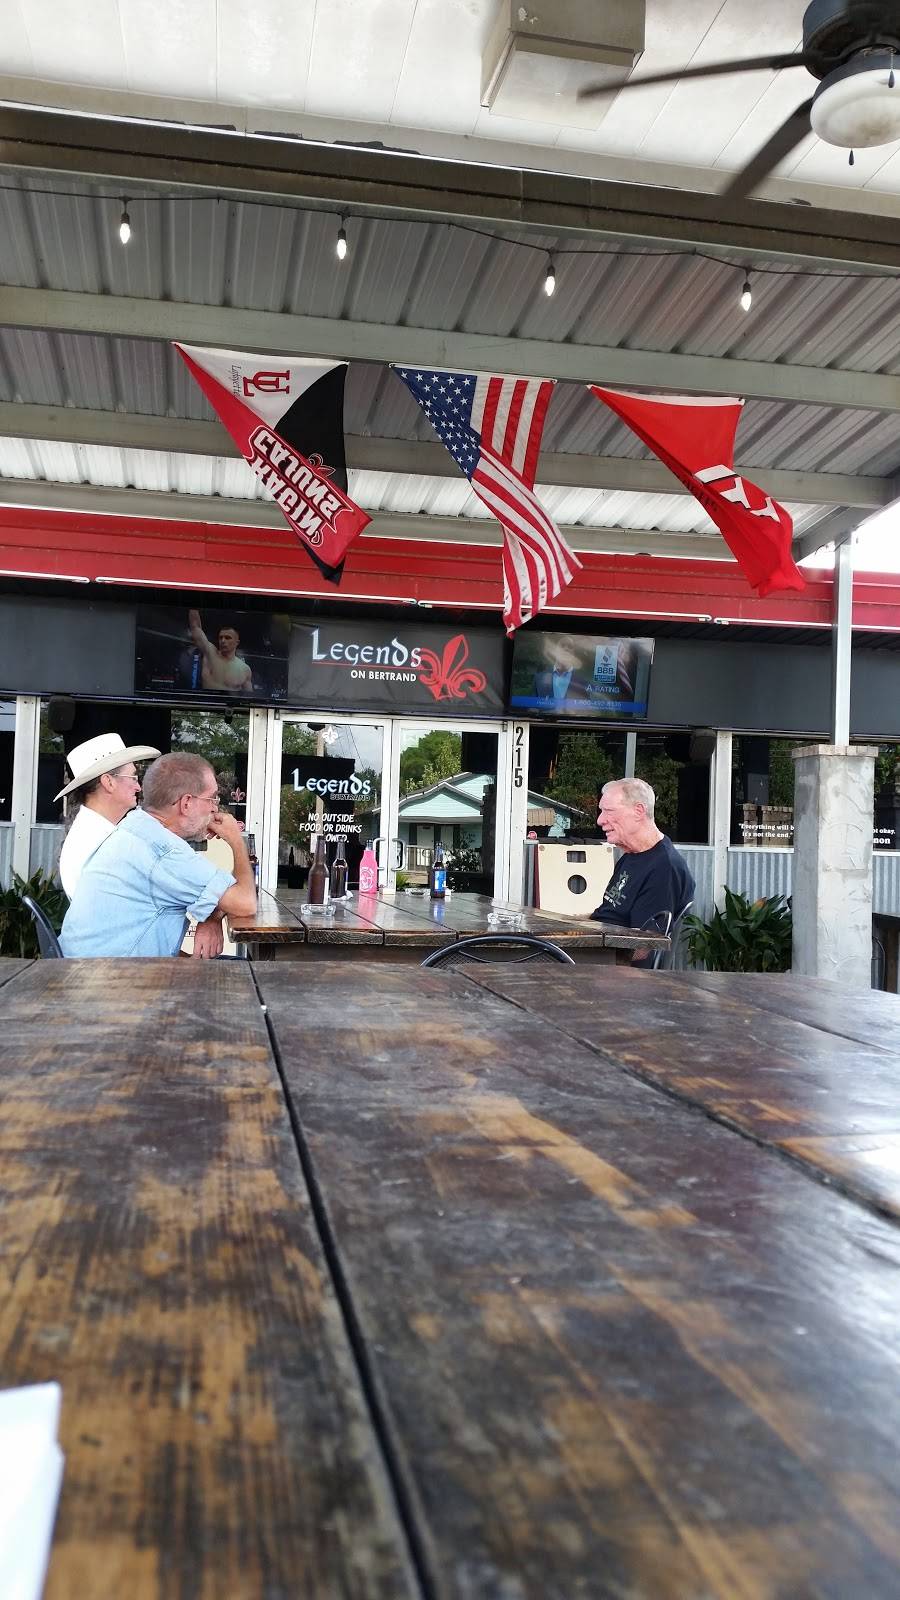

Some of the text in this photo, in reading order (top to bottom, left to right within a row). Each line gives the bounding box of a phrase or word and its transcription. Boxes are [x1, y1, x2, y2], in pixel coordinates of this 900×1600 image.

[310, 627, 422, 668] Legends
[350, 670, 417, 682] ON BERTRAND
[597, 666, 614, 674] BBB
[514, 726, 524, 788] 215
[291, 767, 371, 796] Legends
[308, 813, 355, 822] NO OUTSIDE
[299, 822, 362, 834] FOOD OR DRINKS
